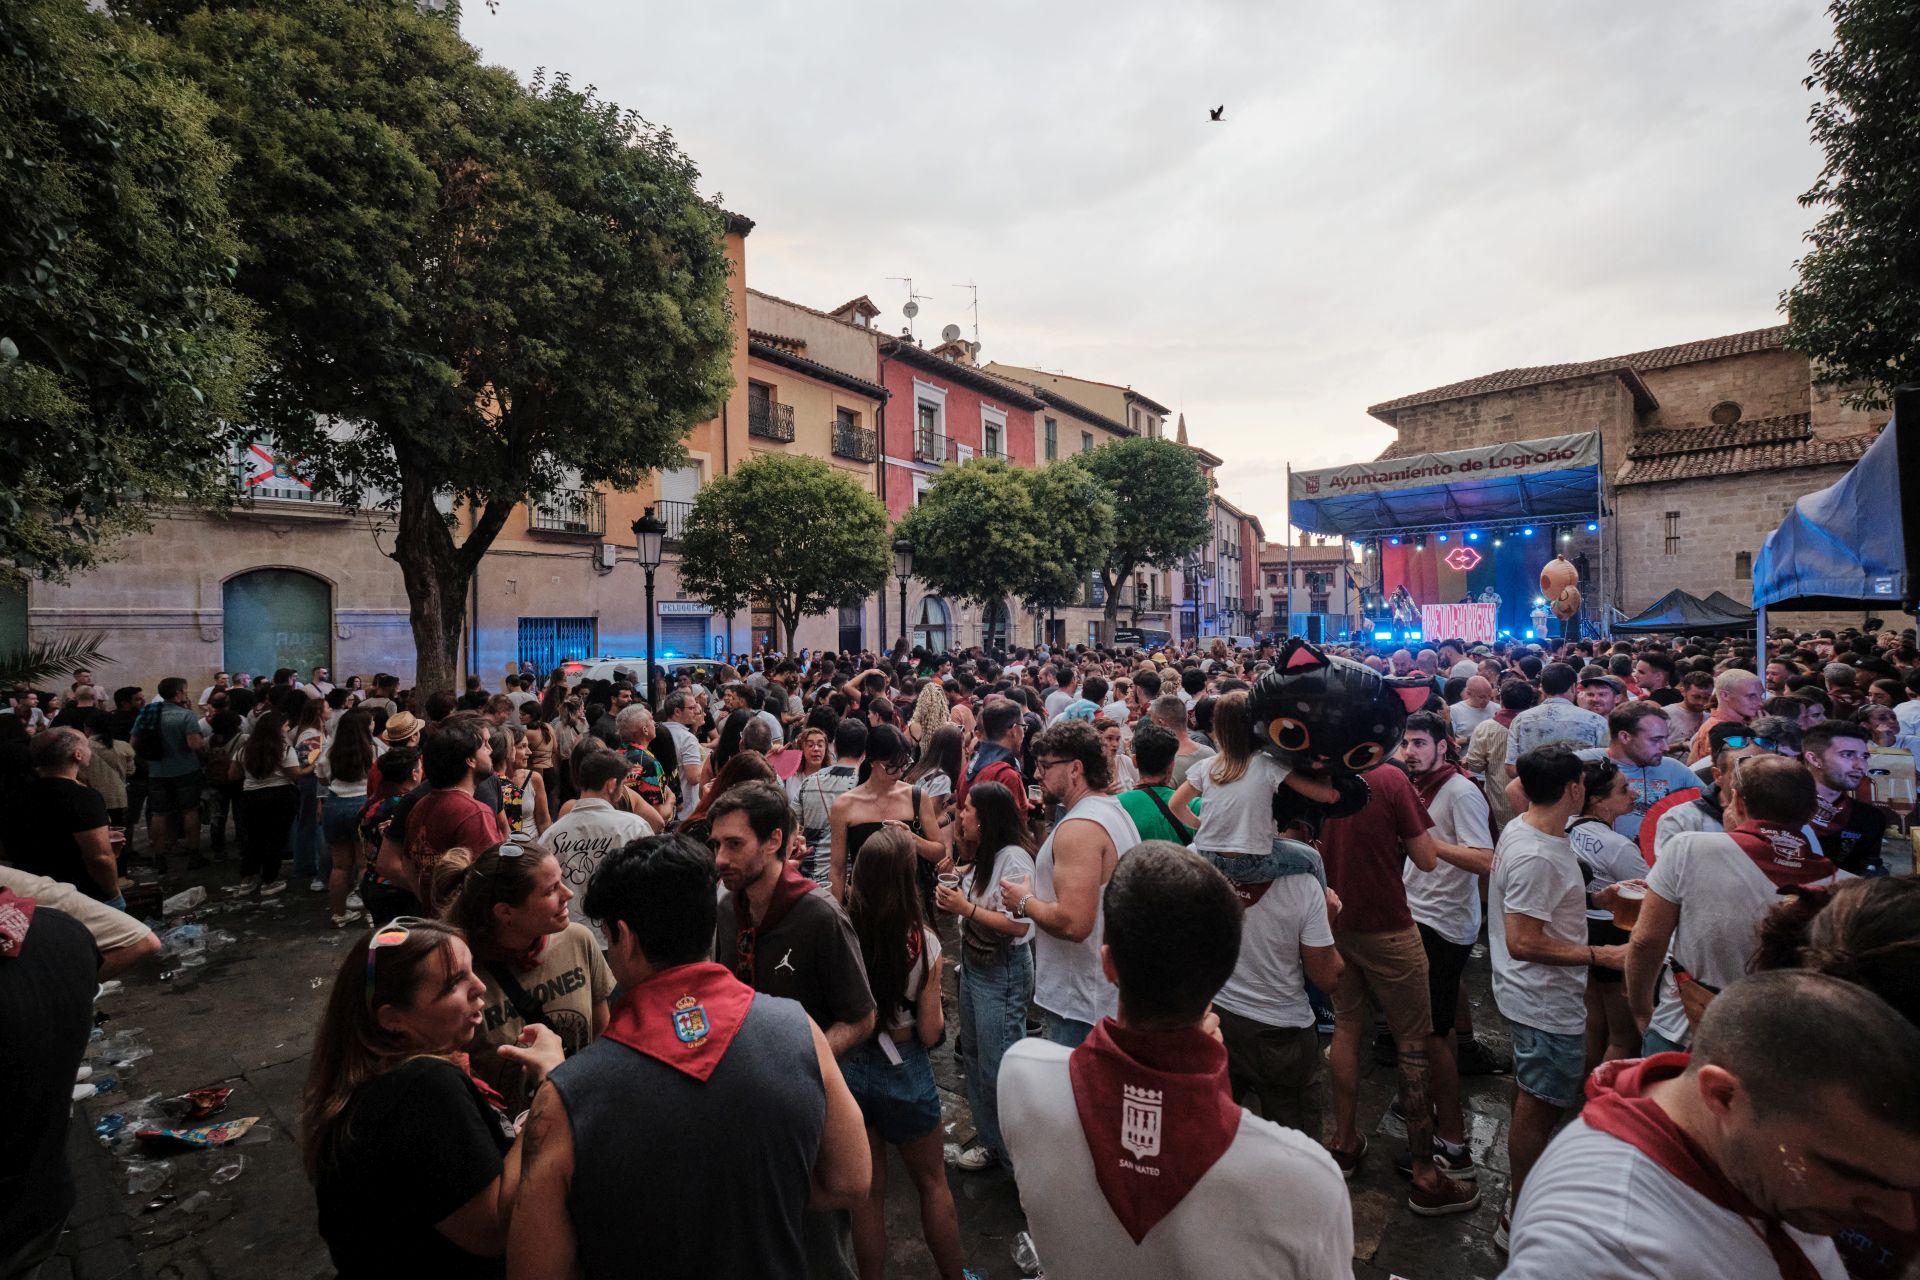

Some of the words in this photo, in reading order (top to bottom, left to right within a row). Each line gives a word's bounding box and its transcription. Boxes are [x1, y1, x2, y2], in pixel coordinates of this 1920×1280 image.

[1329, 463, 1452, 490] Ayuntamiento
[1459, 458, 1483, 472] de
[1488, 447, 1575, 469] Logroño
[484, 966, 586, 1031] RAONES
[1119, 1158, 1134, 1169] SAN
[1135, 1164, 1160, 1177] MATEO
